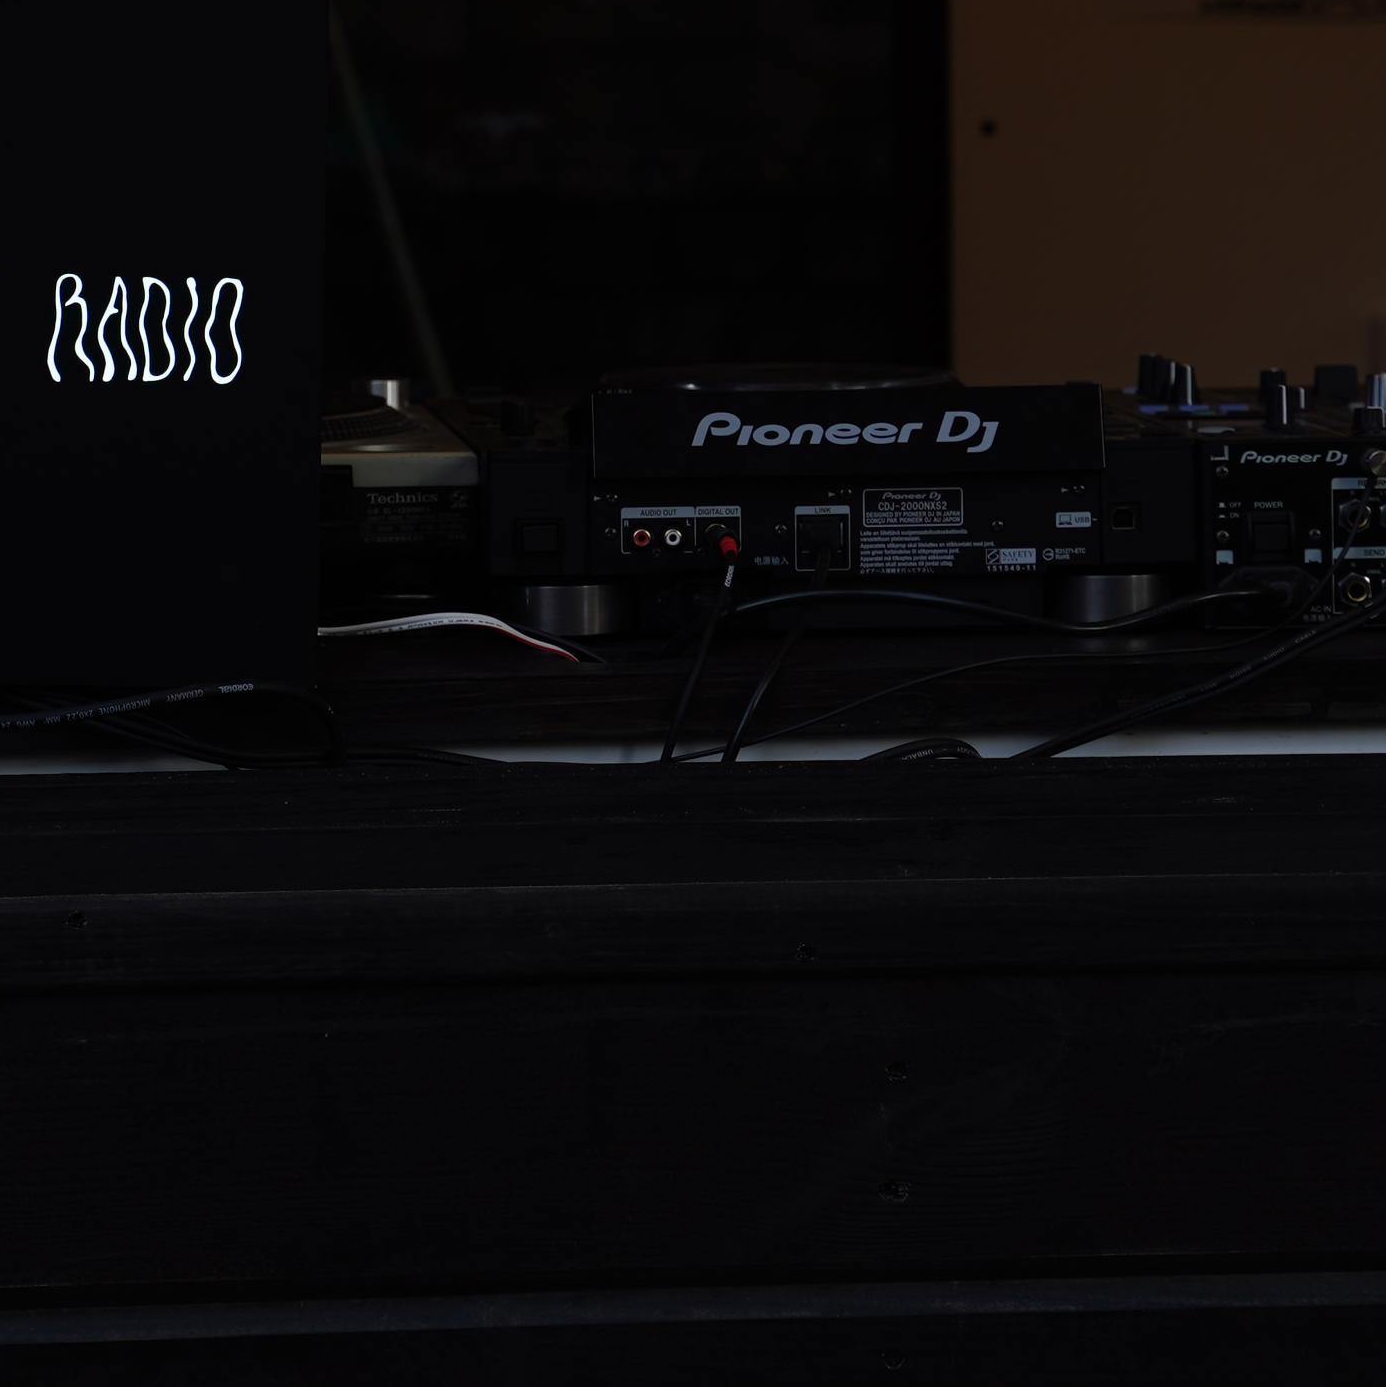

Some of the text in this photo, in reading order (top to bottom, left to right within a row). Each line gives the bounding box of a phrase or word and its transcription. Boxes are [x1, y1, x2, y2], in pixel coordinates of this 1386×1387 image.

[46, 273, 244, 384] RADIO
[691, 411, 923, 446] Pioneer
[1240, 450, 1321, 464] Pioneer
[366, 492, 438, 505] Technics
[878, 501, 948, 511] CDJ-2000NXS2
[1254, 501, 1284, 509] POWER
[640, 509, 662, 517] AUDIO
[698, 508, 723, 516] DIGITAL
